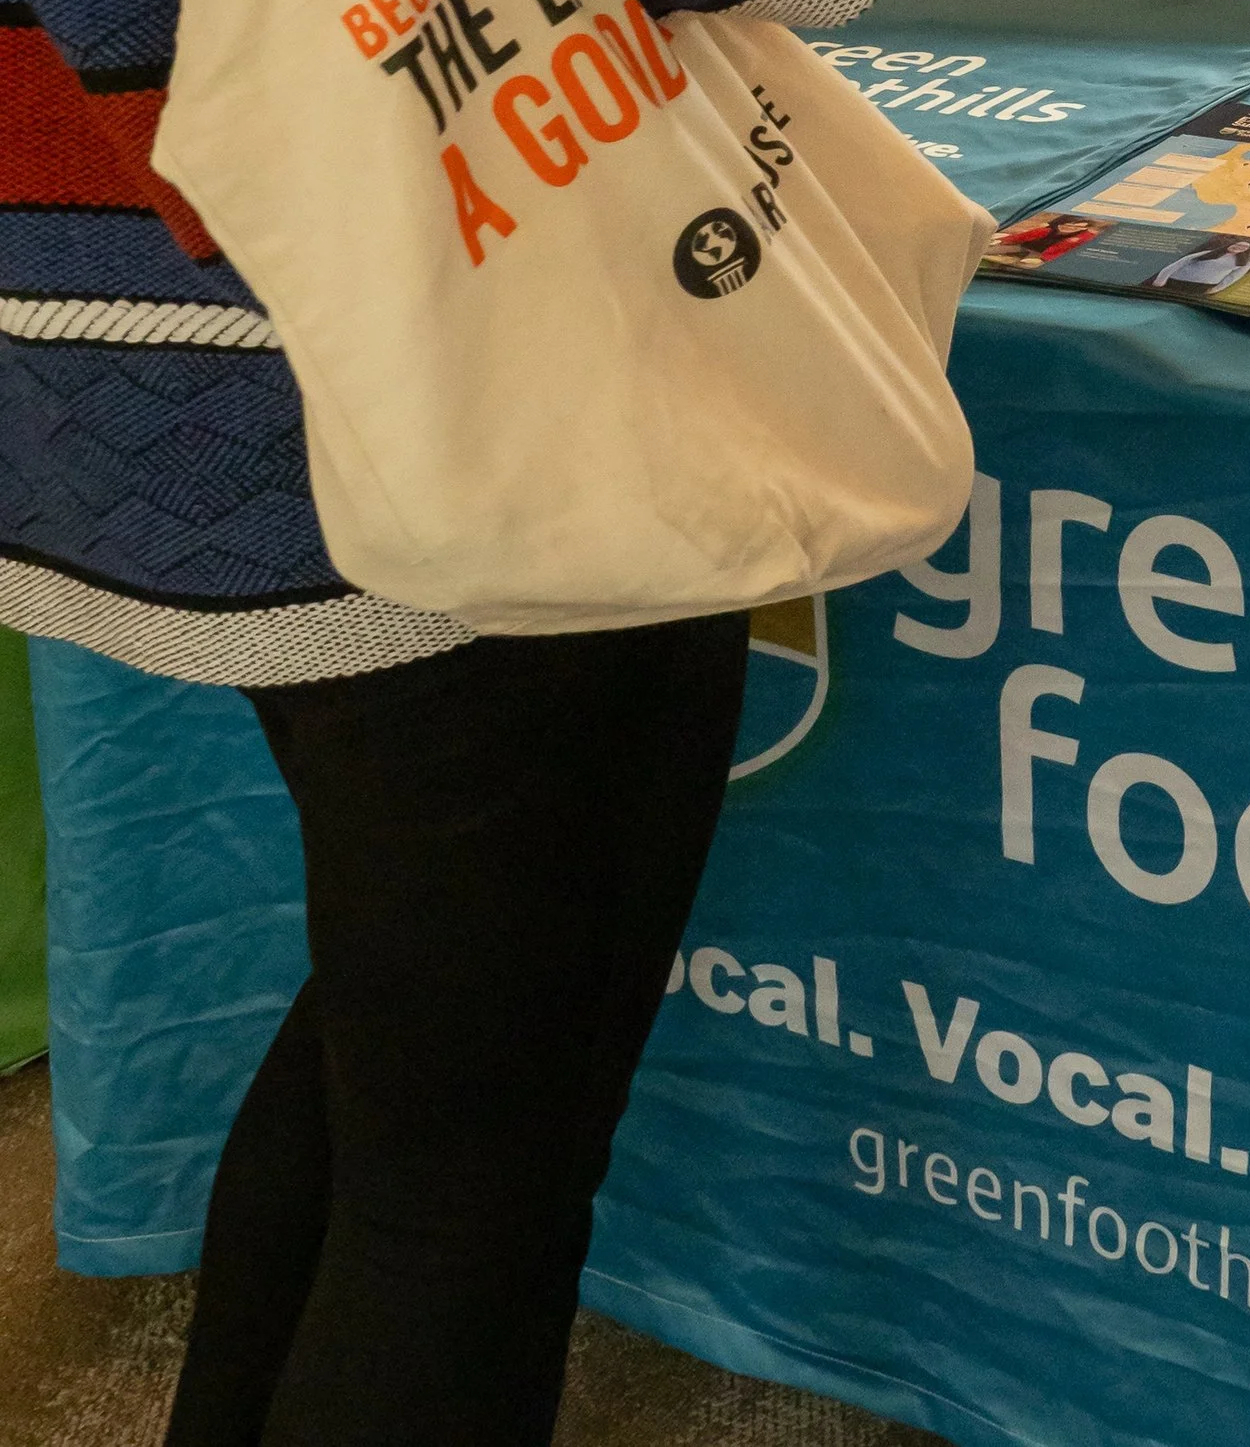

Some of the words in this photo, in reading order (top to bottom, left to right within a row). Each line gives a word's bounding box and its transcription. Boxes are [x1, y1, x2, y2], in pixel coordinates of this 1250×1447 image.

[806, 40, 987, 77] reen
[440, 143, 517, 268] A
[901, 979, 1248, 1176] Vocal.
